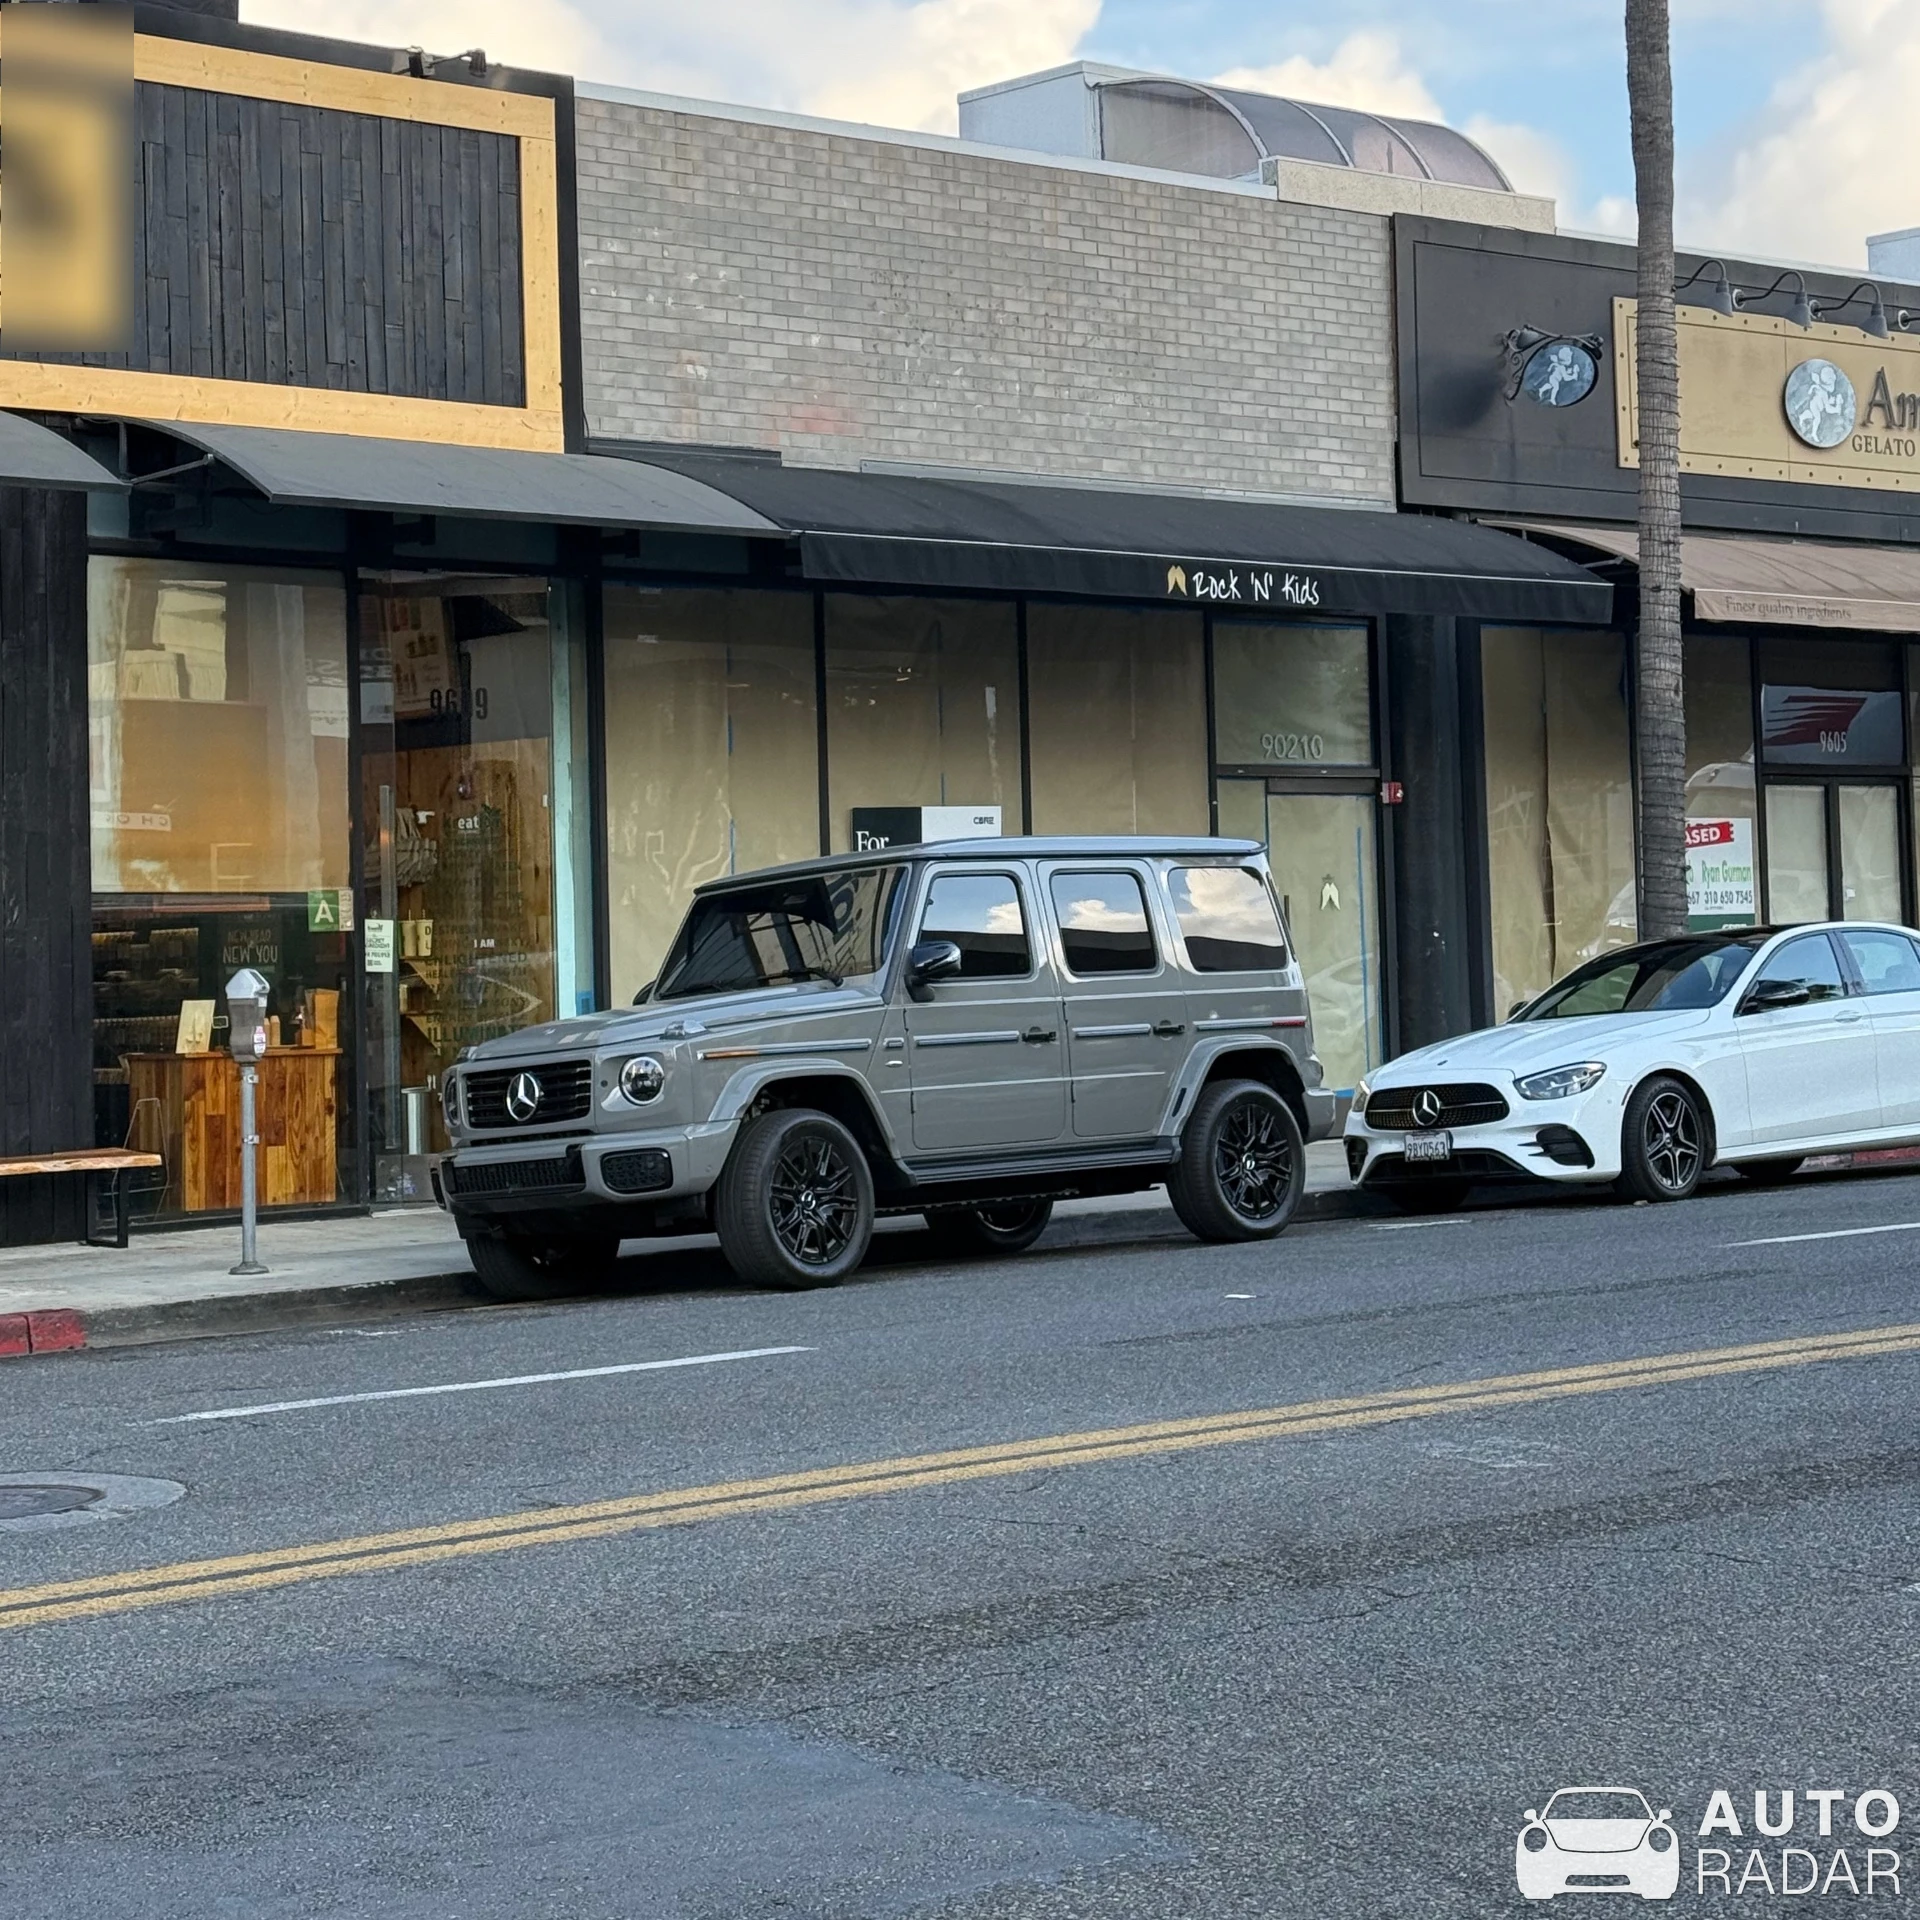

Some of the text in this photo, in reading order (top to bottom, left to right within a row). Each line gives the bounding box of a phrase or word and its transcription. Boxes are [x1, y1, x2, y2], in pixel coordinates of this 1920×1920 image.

[1852, 434, 1916, 457] GELATO
[1192, 569, 1241, 599] Rock
[1281, 573, 1319, 605] Kids
[1758, 599, 1793, 618] quality
[1796, 601, 1852, 619] ingredients
[1262, 733, 1324, 759] 90210
[1819, 731, 1847, 753] 9605
[855, 830, 890, 852] For
[1685, 827, 1721, 844] ASED
[1704, 891, 1718, 904] 310
[314, 899, 334, 924] A
[222, 945, 279, 964] NEW YOU
[480, 939, 495, 948] AM
